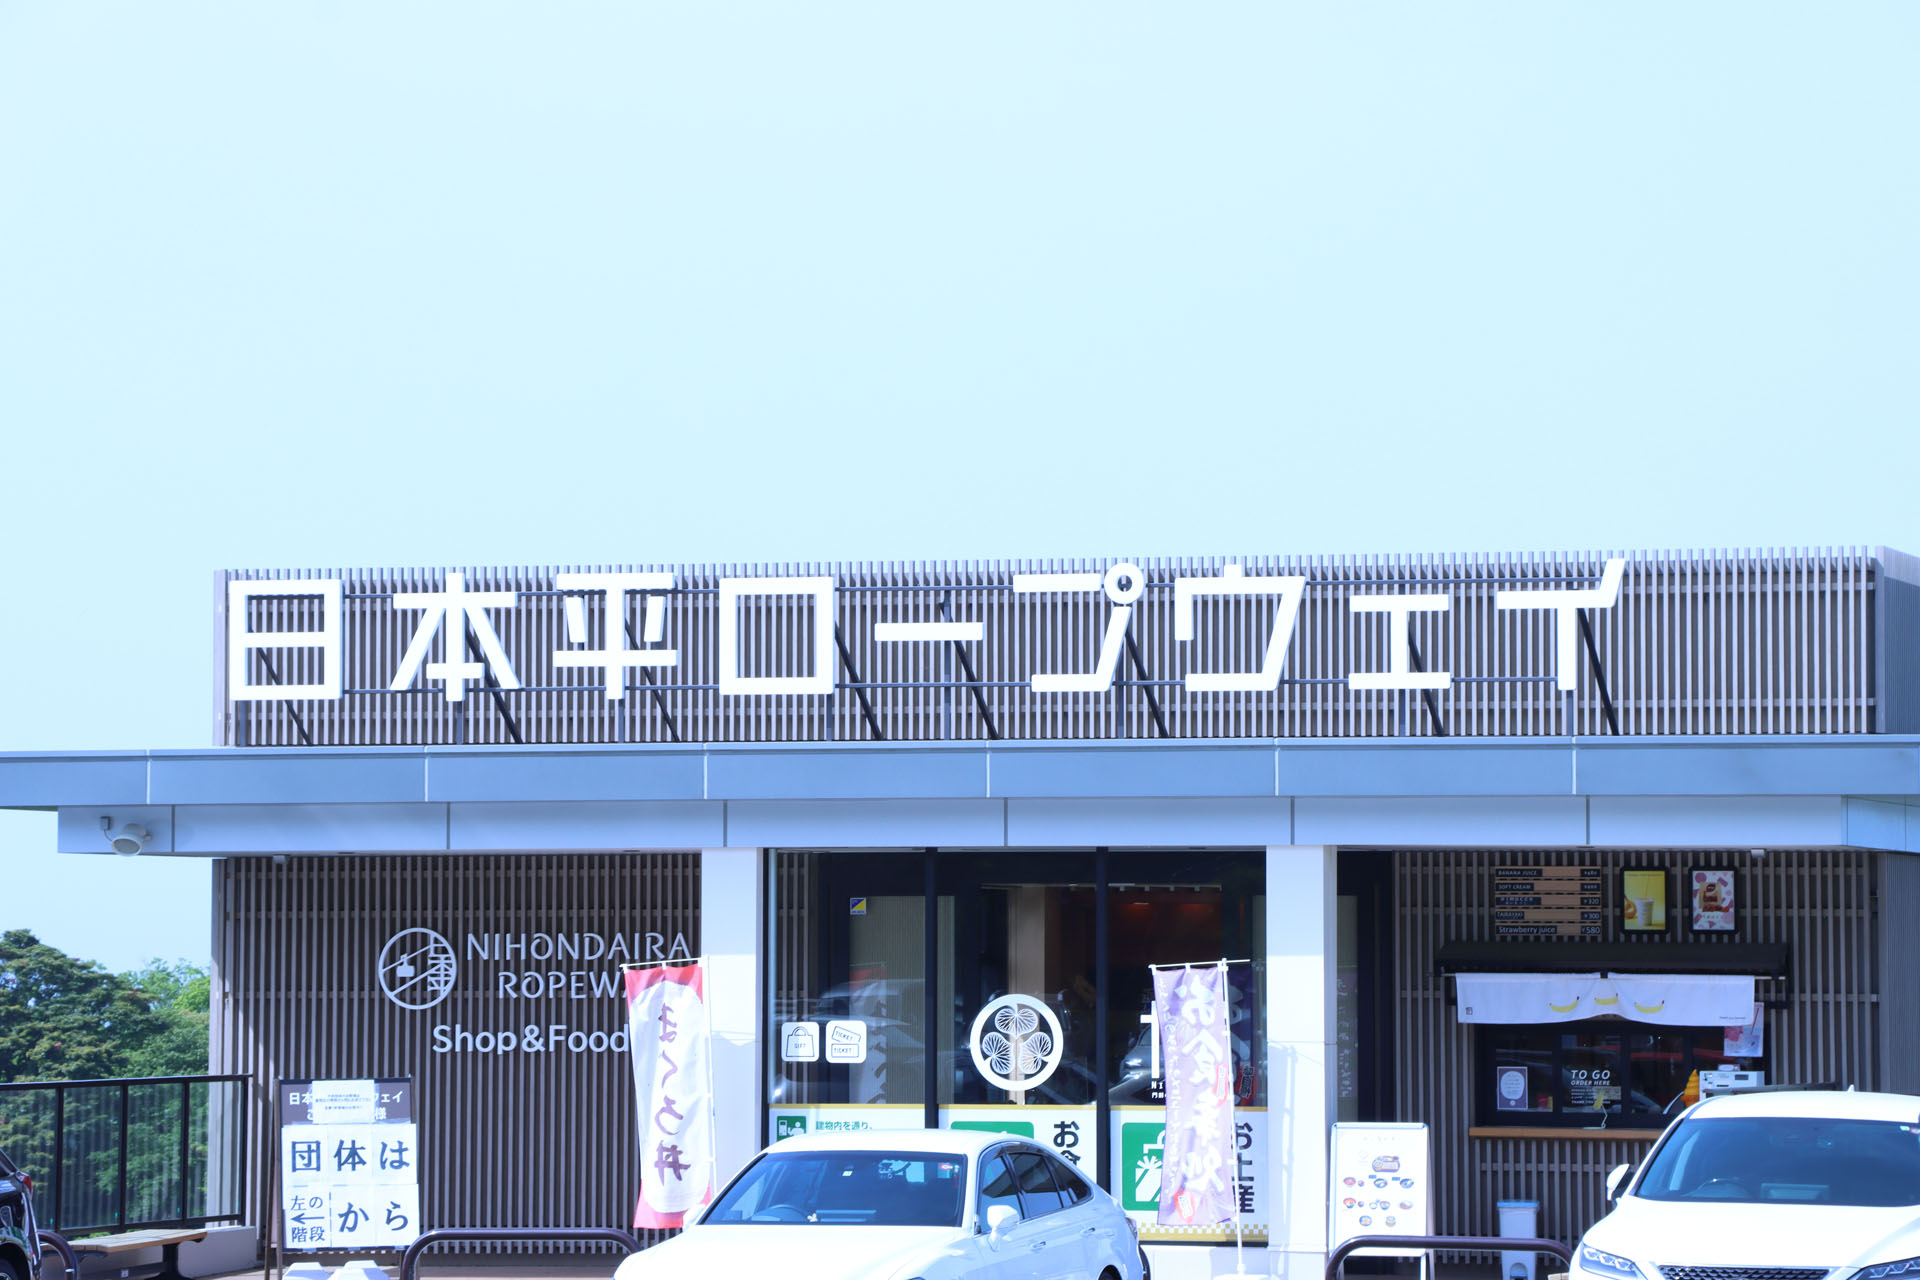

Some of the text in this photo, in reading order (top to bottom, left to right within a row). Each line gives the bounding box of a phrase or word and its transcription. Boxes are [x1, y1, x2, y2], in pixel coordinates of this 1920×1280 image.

[1498, 926, 1601, 934] Strawberry juice ¥580
[467, 932, 692, 961] NIHONDAIRA
[498, 970, 628, 1000] ROPEW
[835, 1029, 855, 1042] TICKET
[1570, 1069, 1611, 1080] TO GO
[291, 1139, 410, 1173] 団体は
[291, 1195, 324, 1211] 左の
[338, 1201, 409, 1233] から
[291, 1226, 326, 1243] 階段
